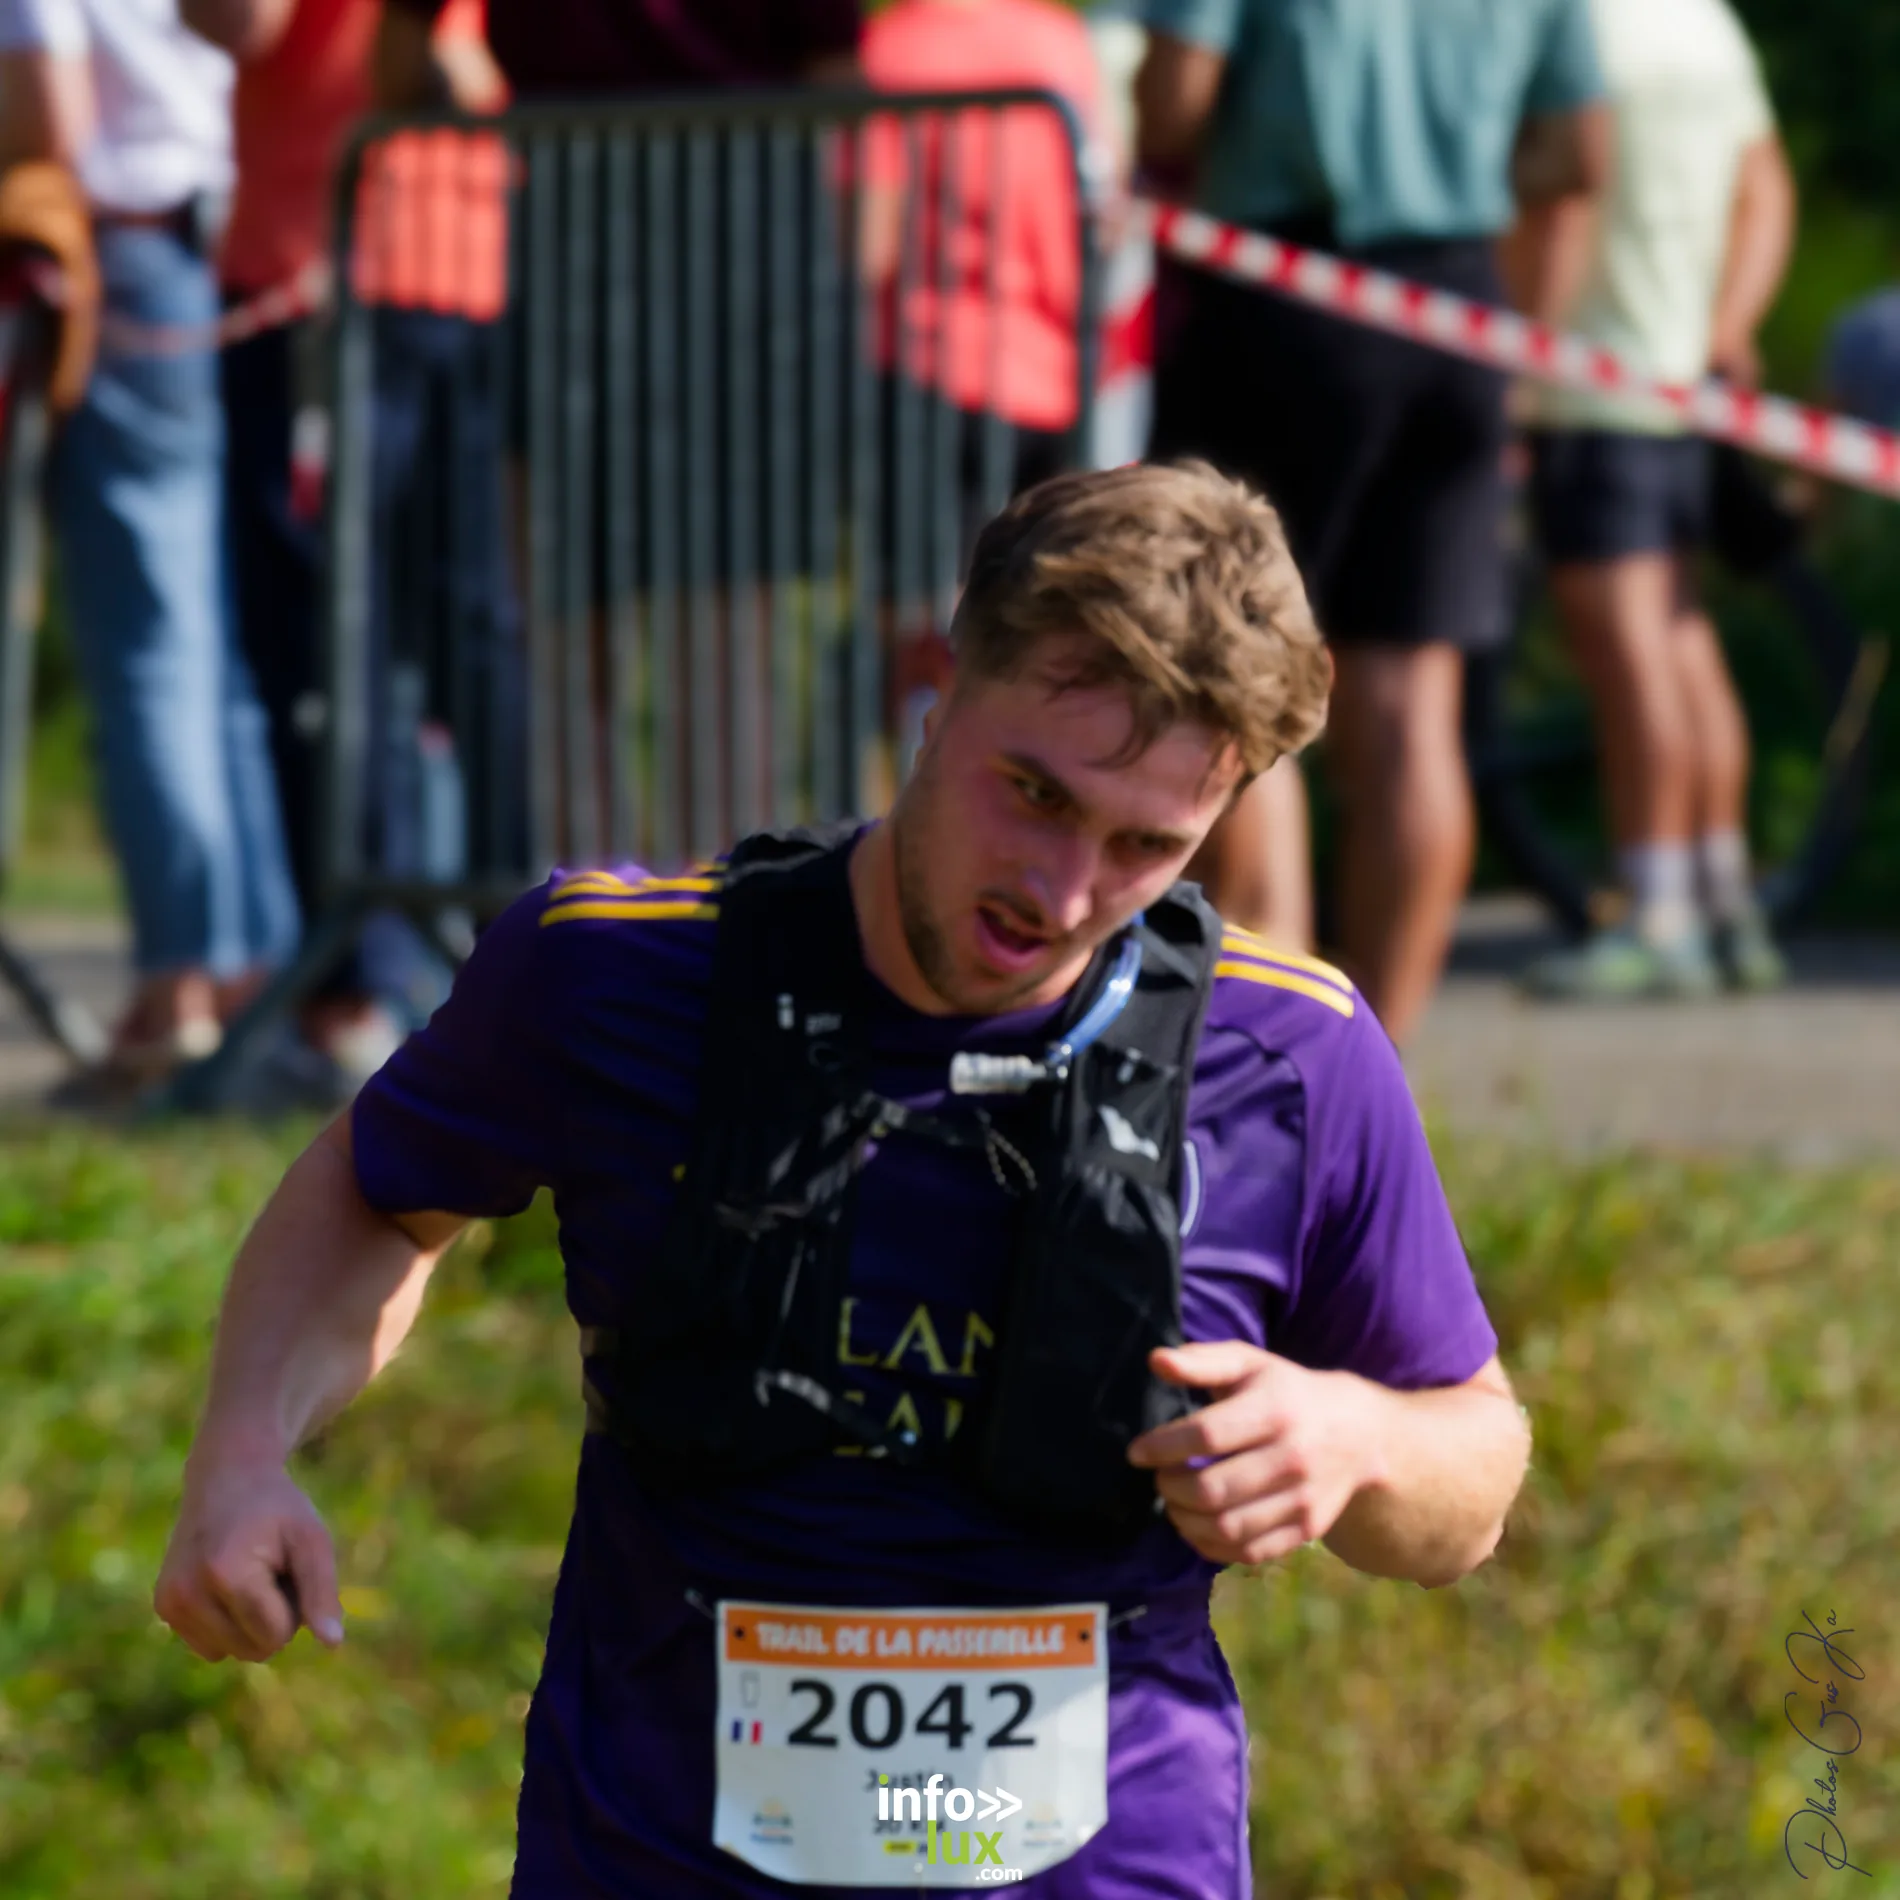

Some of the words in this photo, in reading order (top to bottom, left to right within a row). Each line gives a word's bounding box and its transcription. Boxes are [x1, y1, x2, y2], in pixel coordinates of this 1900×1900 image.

[755, 1621, 829, 1655] TRAIL
[835, 1625, 871, 1656] DE
[876, 1625, 911, 1658] LA
[917, 1624, 1065, 1657] PASSERELLE
[787, 1678, 1037, 1752] 2042
